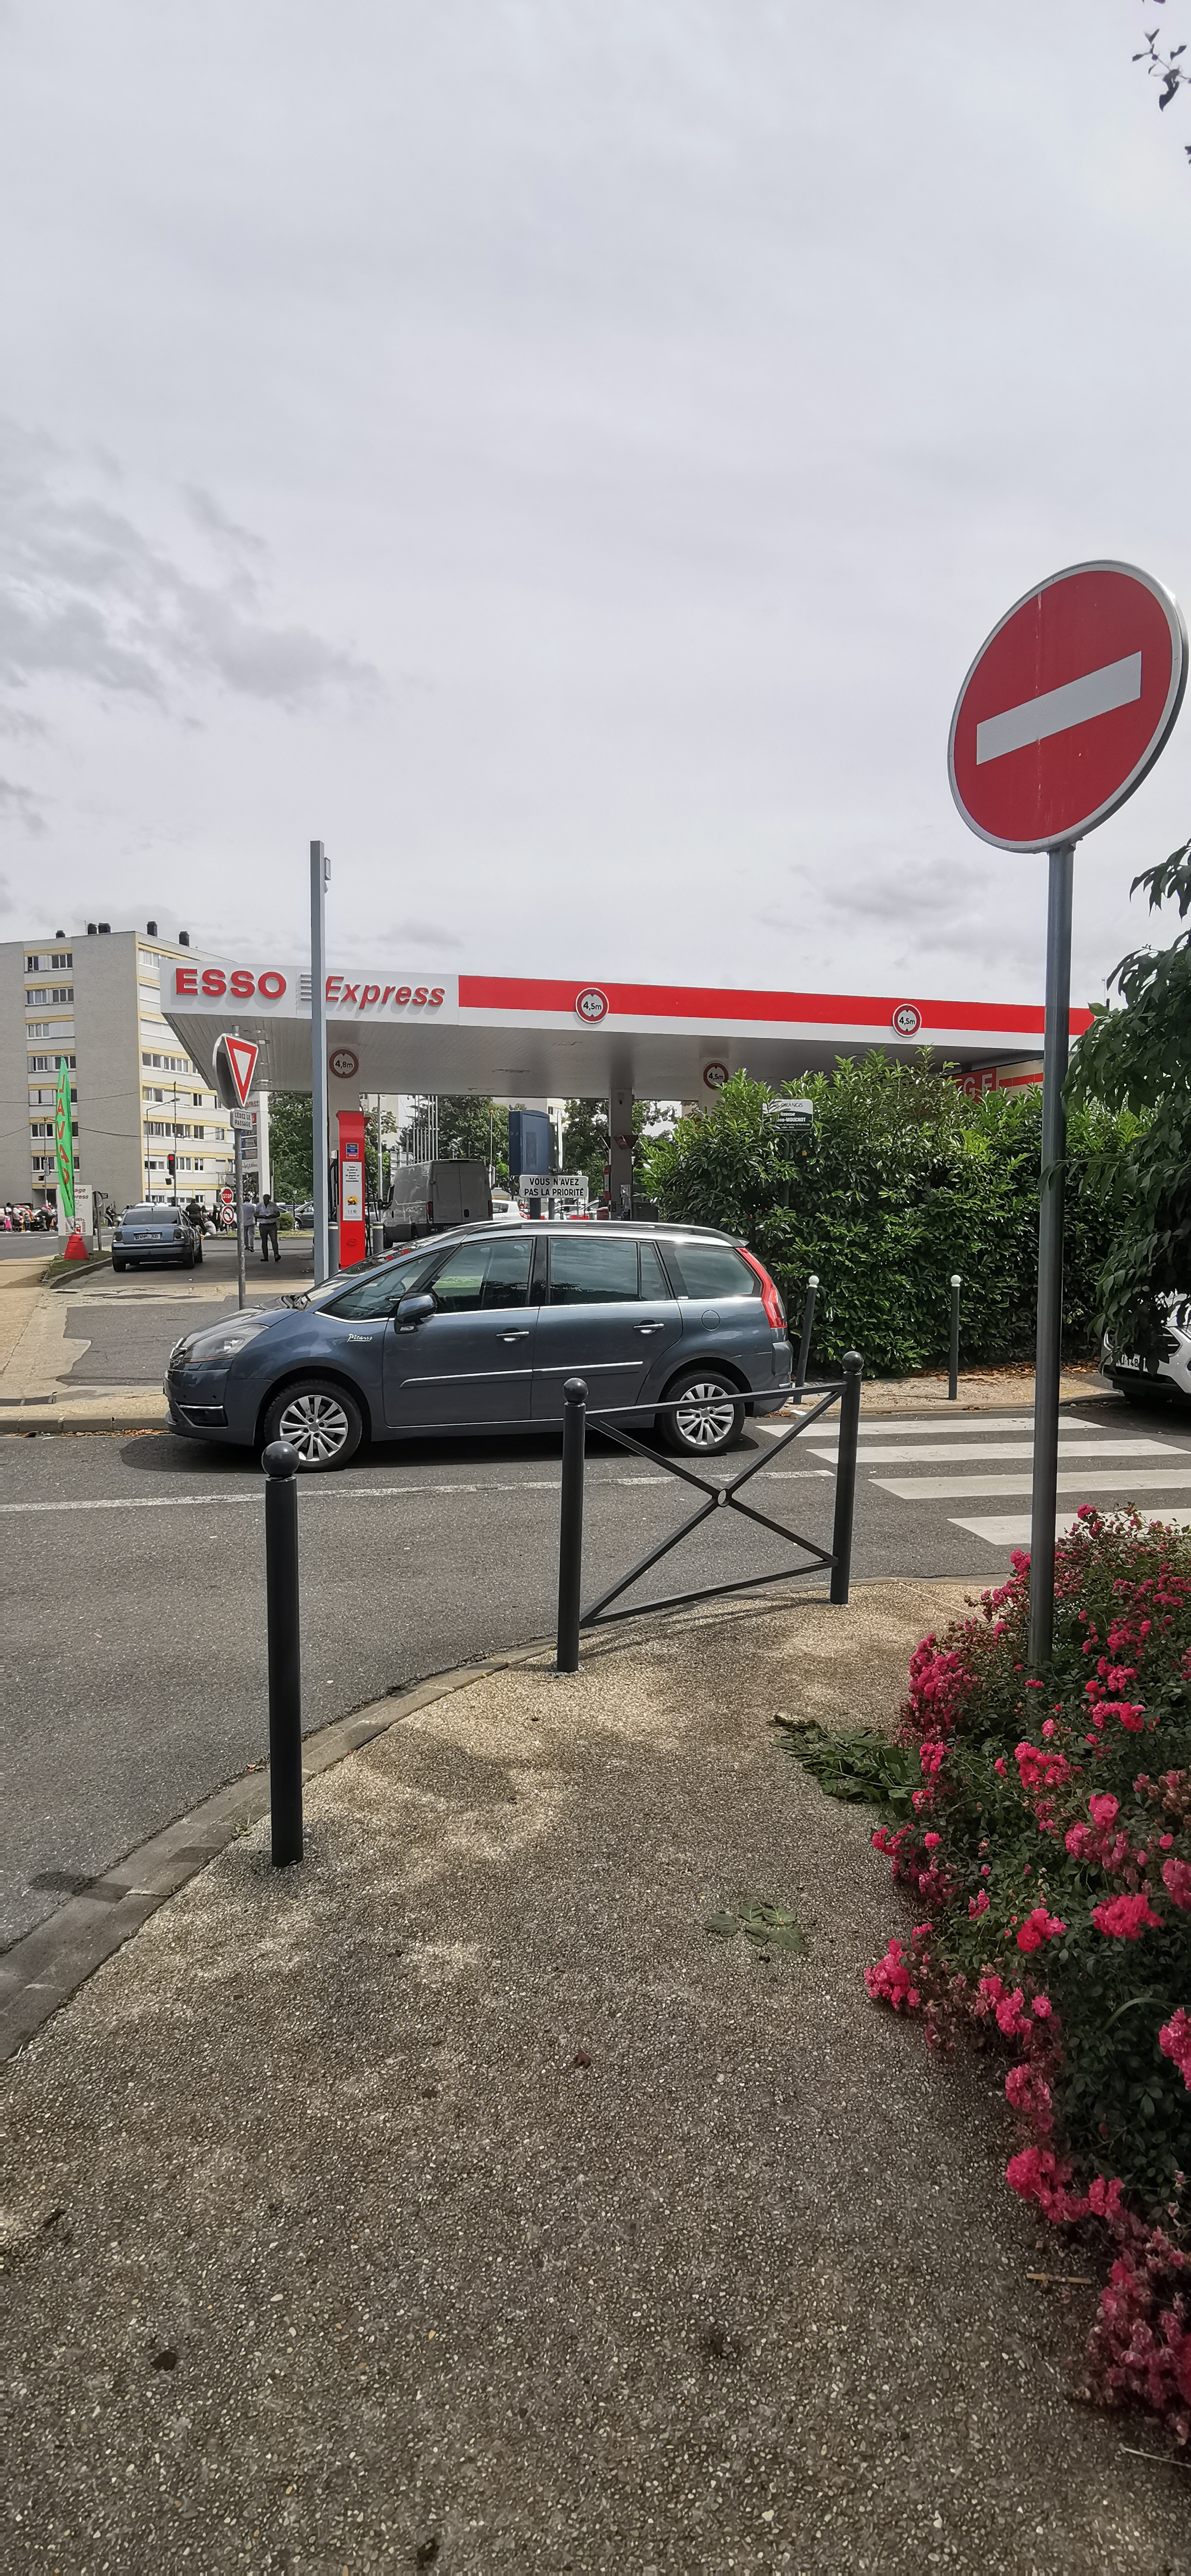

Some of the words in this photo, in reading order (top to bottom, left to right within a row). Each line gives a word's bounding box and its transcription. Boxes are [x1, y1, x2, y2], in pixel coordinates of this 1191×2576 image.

[176, 968, 287, 999] ESSO
[325, 976, 446, 1009] Express
[583, 1001, 602, 1011] 4,5m
[899, 1016, 915, 1025] 4,5m
[335, 1060, 353, 1069] 4,8m
[708, 1072, 724, 1080] 4,5m
[963, 1073, 993, 1101] GE
[553, 1178, 579, 1186] N'AVEZ
[552, 1187, 584, 1196] PRIORITÉ
